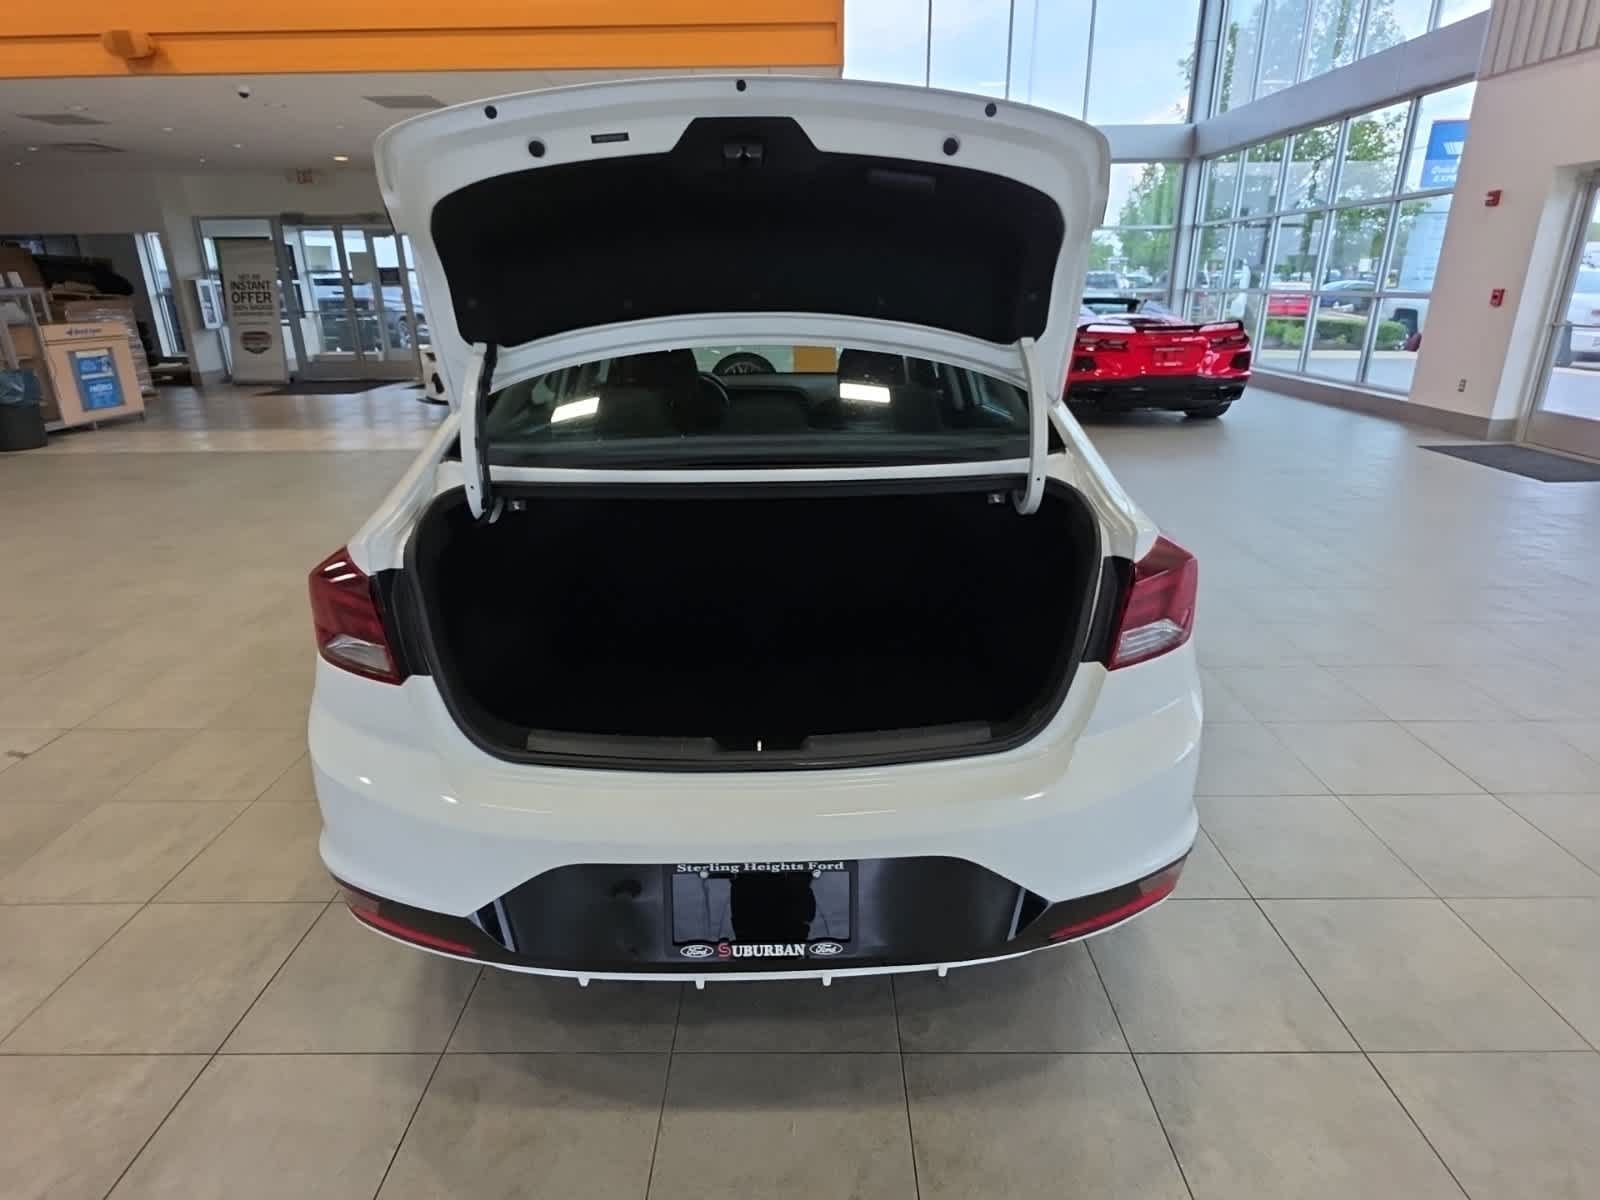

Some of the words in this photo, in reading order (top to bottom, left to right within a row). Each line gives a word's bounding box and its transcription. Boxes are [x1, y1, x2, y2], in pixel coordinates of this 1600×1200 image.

[231, 280, 271, 290] INSTANT
[232, 291, 272, 303] OFFER
[677, 863, 739, 873] Sterling
[744, 862, 804, 872] Heights
[808, 861, 844, 871] Ford
[684, 946, 710, 957] Ford
[718, 942, 806, 959] SUBURBAN
[813, 943, 839, 954] Ford
